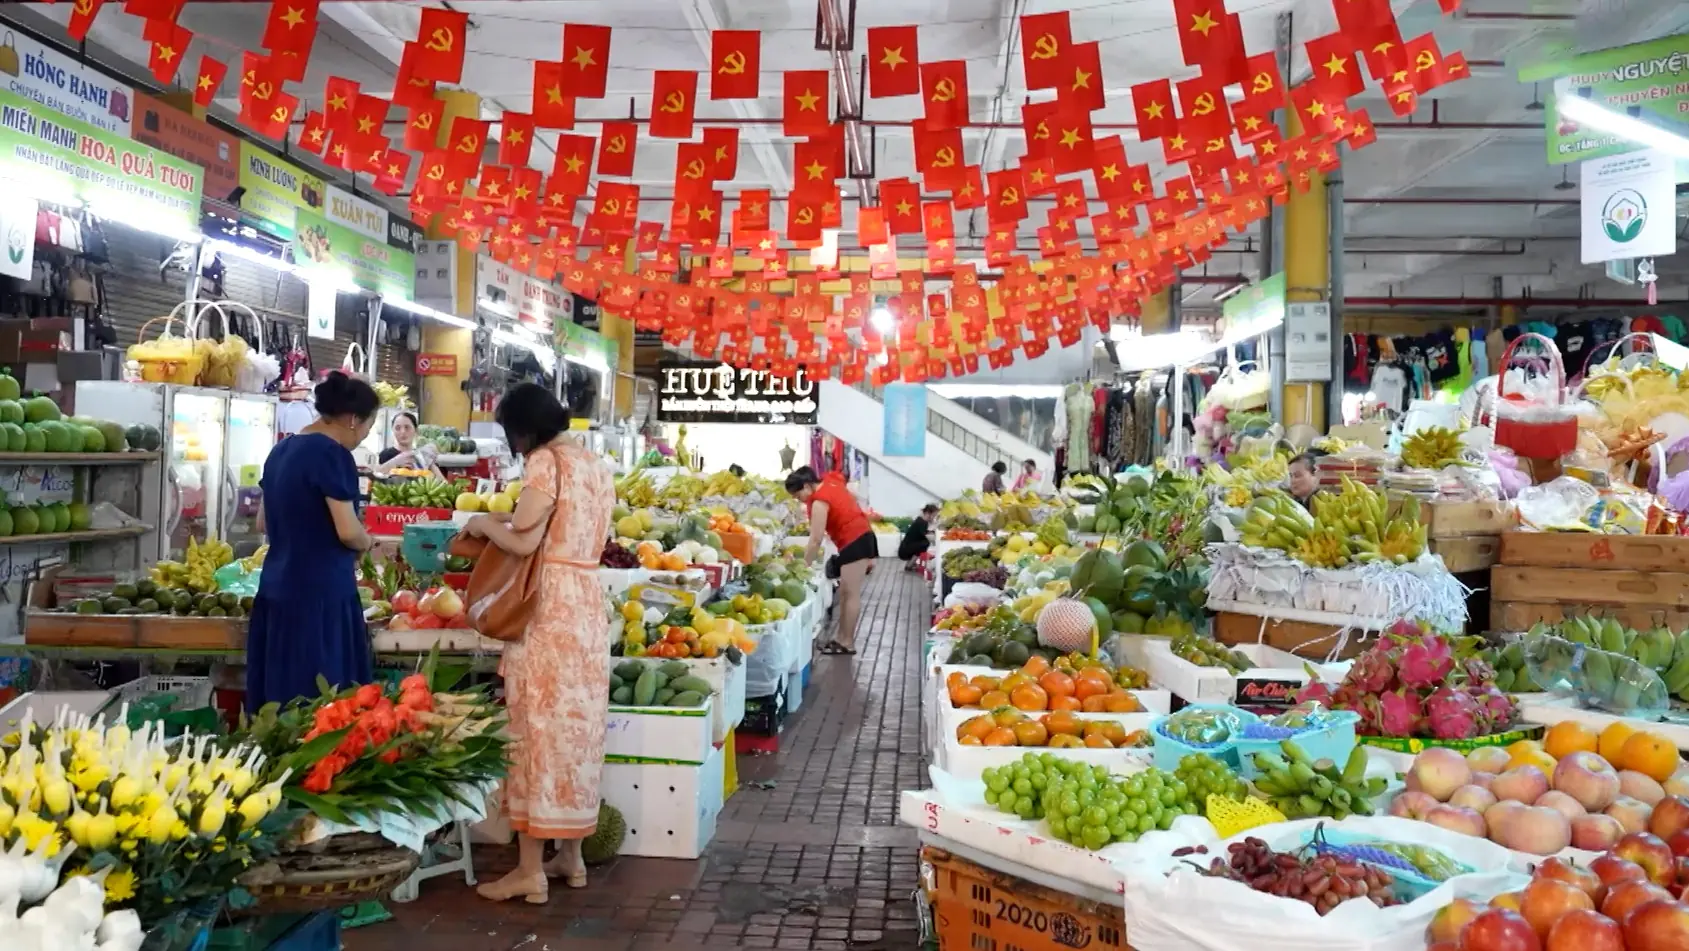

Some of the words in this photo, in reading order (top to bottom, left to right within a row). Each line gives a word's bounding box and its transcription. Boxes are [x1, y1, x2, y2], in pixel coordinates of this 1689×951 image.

[9, 80, 45, 105] CHUYÊN
[69, 74, 108, 108] HẠNH
[40, 120, 77, 150] MẠNH
[80, 136, 116, 165] HOA
[122, 152, 155, 178] QUẢ
[160, 165, 194, 192] TƯƠI
[332, 196, 363, 224] XUÂN
[995, 898, 1048, 933] 2020
